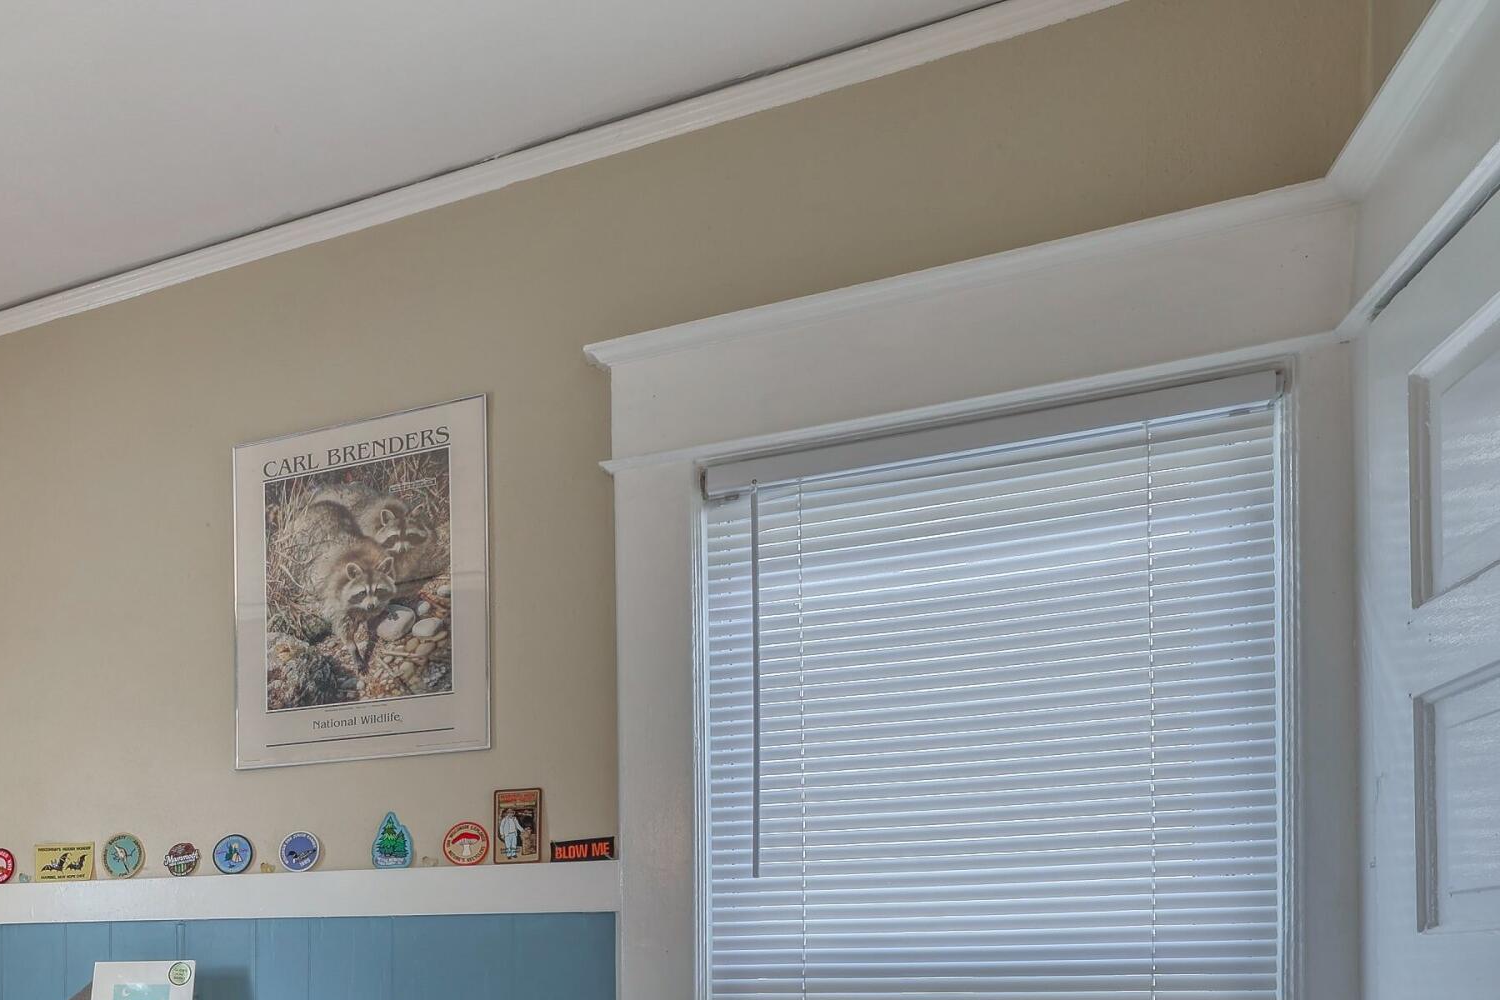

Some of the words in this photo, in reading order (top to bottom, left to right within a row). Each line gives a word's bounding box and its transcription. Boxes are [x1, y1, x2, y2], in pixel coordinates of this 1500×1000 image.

[263, 453, 320, 478] CARL
[327, 426, 450, 466] BRENDERS
[312, 716, 357, 730] National
[360, 712, 401, 725] Wildlife
[555, 844, 588, 859] BLOW
[591, 842, 610, 857] ME
